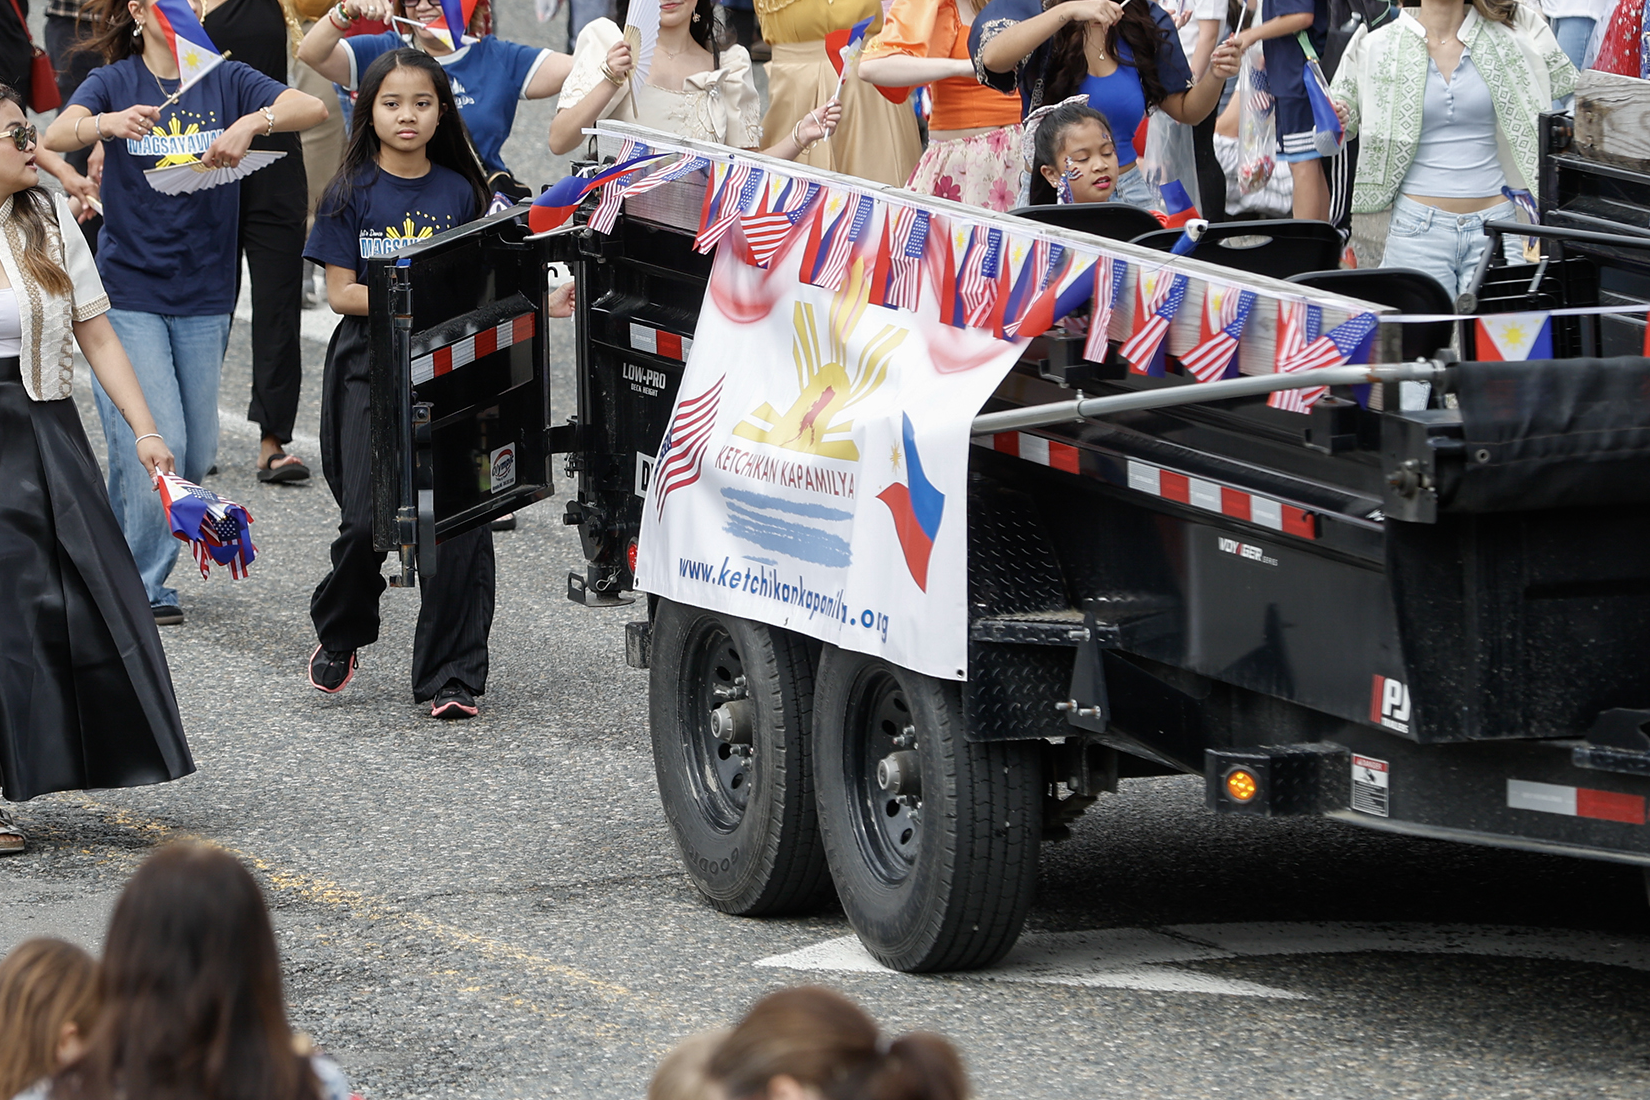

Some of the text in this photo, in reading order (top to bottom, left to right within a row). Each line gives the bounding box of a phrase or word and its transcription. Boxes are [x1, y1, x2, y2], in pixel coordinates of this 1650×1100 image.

[631, 383, 659, 397] DECK HEIGHT
[714, 445, 855, 500] KETCHIKAN KAPAMILYA
[1381, 677, 1412, 722] PJ
